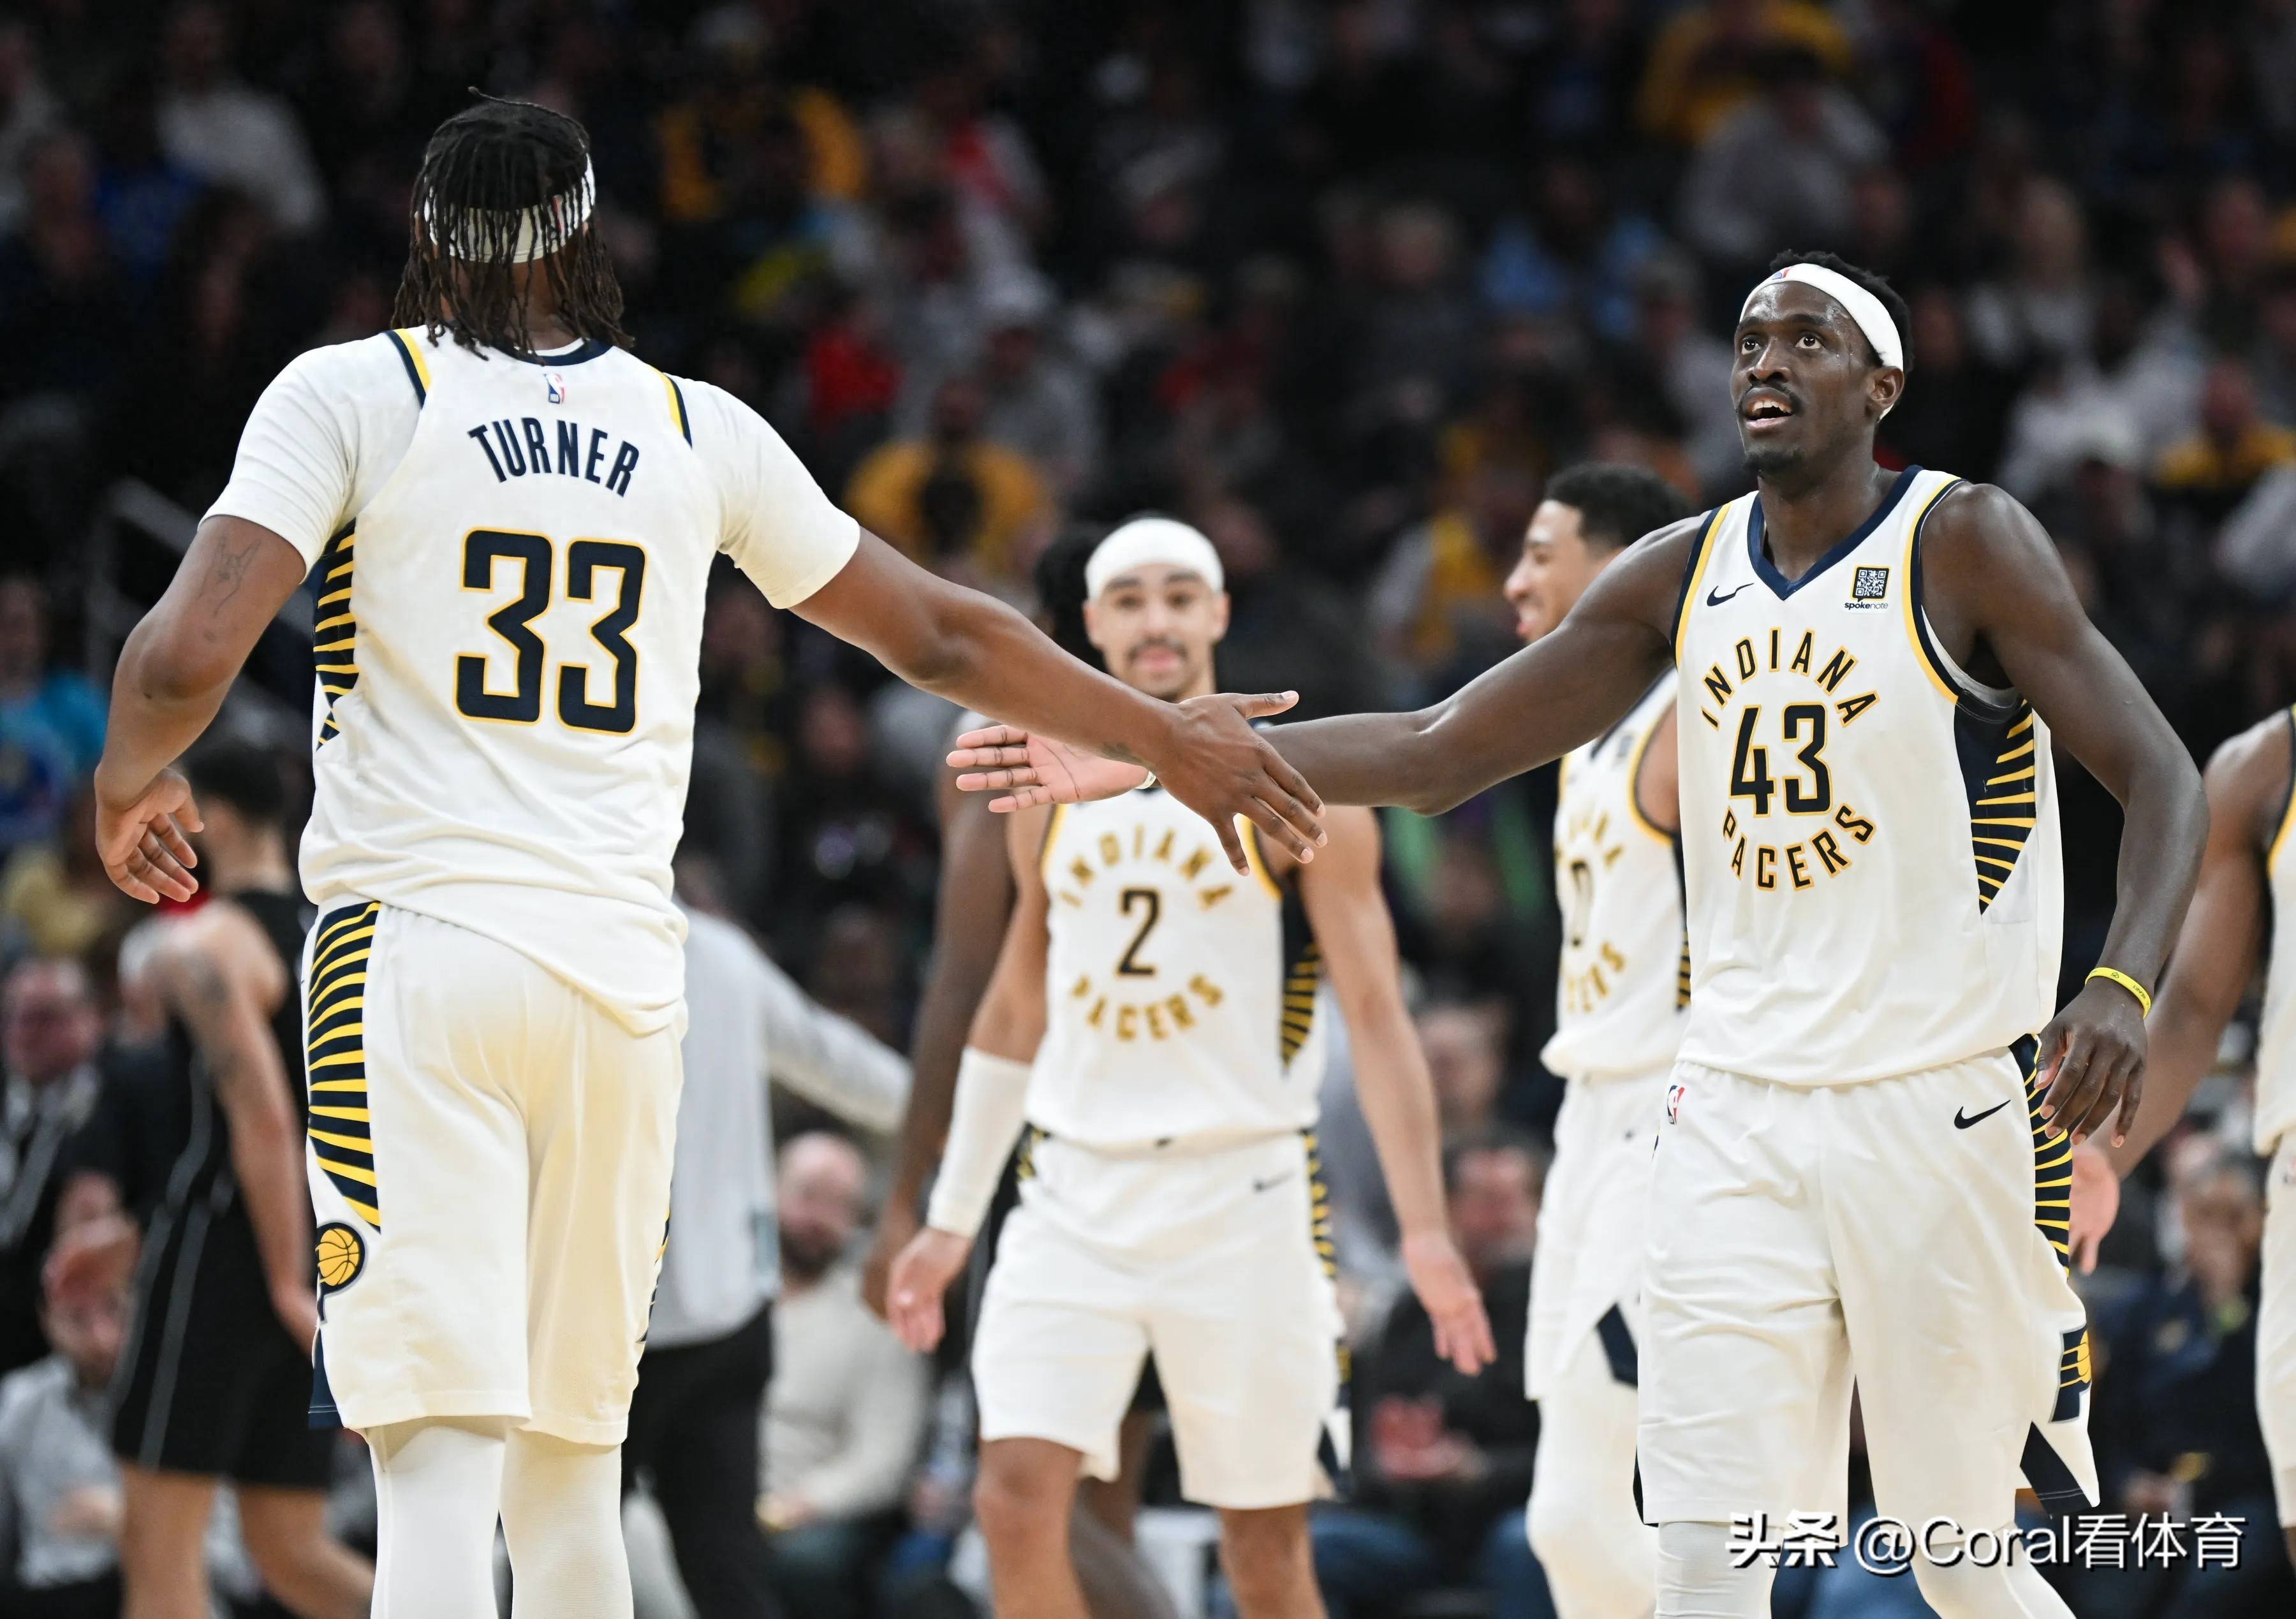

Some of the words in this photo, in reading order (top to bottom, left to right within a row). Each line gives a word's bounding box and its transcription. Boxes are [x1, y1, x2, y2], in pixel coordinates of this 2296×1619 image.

[467, 417, 640, 497] TURNER
[454, 527, 647, 737] 33
[1844, 601, 1888, 610] spokenote
[1701, 627, 1881, 731] INDIANA
[1729, 701, 1834, 818] 43
[1059, 823, 1235, 911] INDIANA
[1723, 803, 1877, 891] PACERS
[1116, 885, 1161, 976] 2
[1070, 976, 1224, 1041] PACERS
